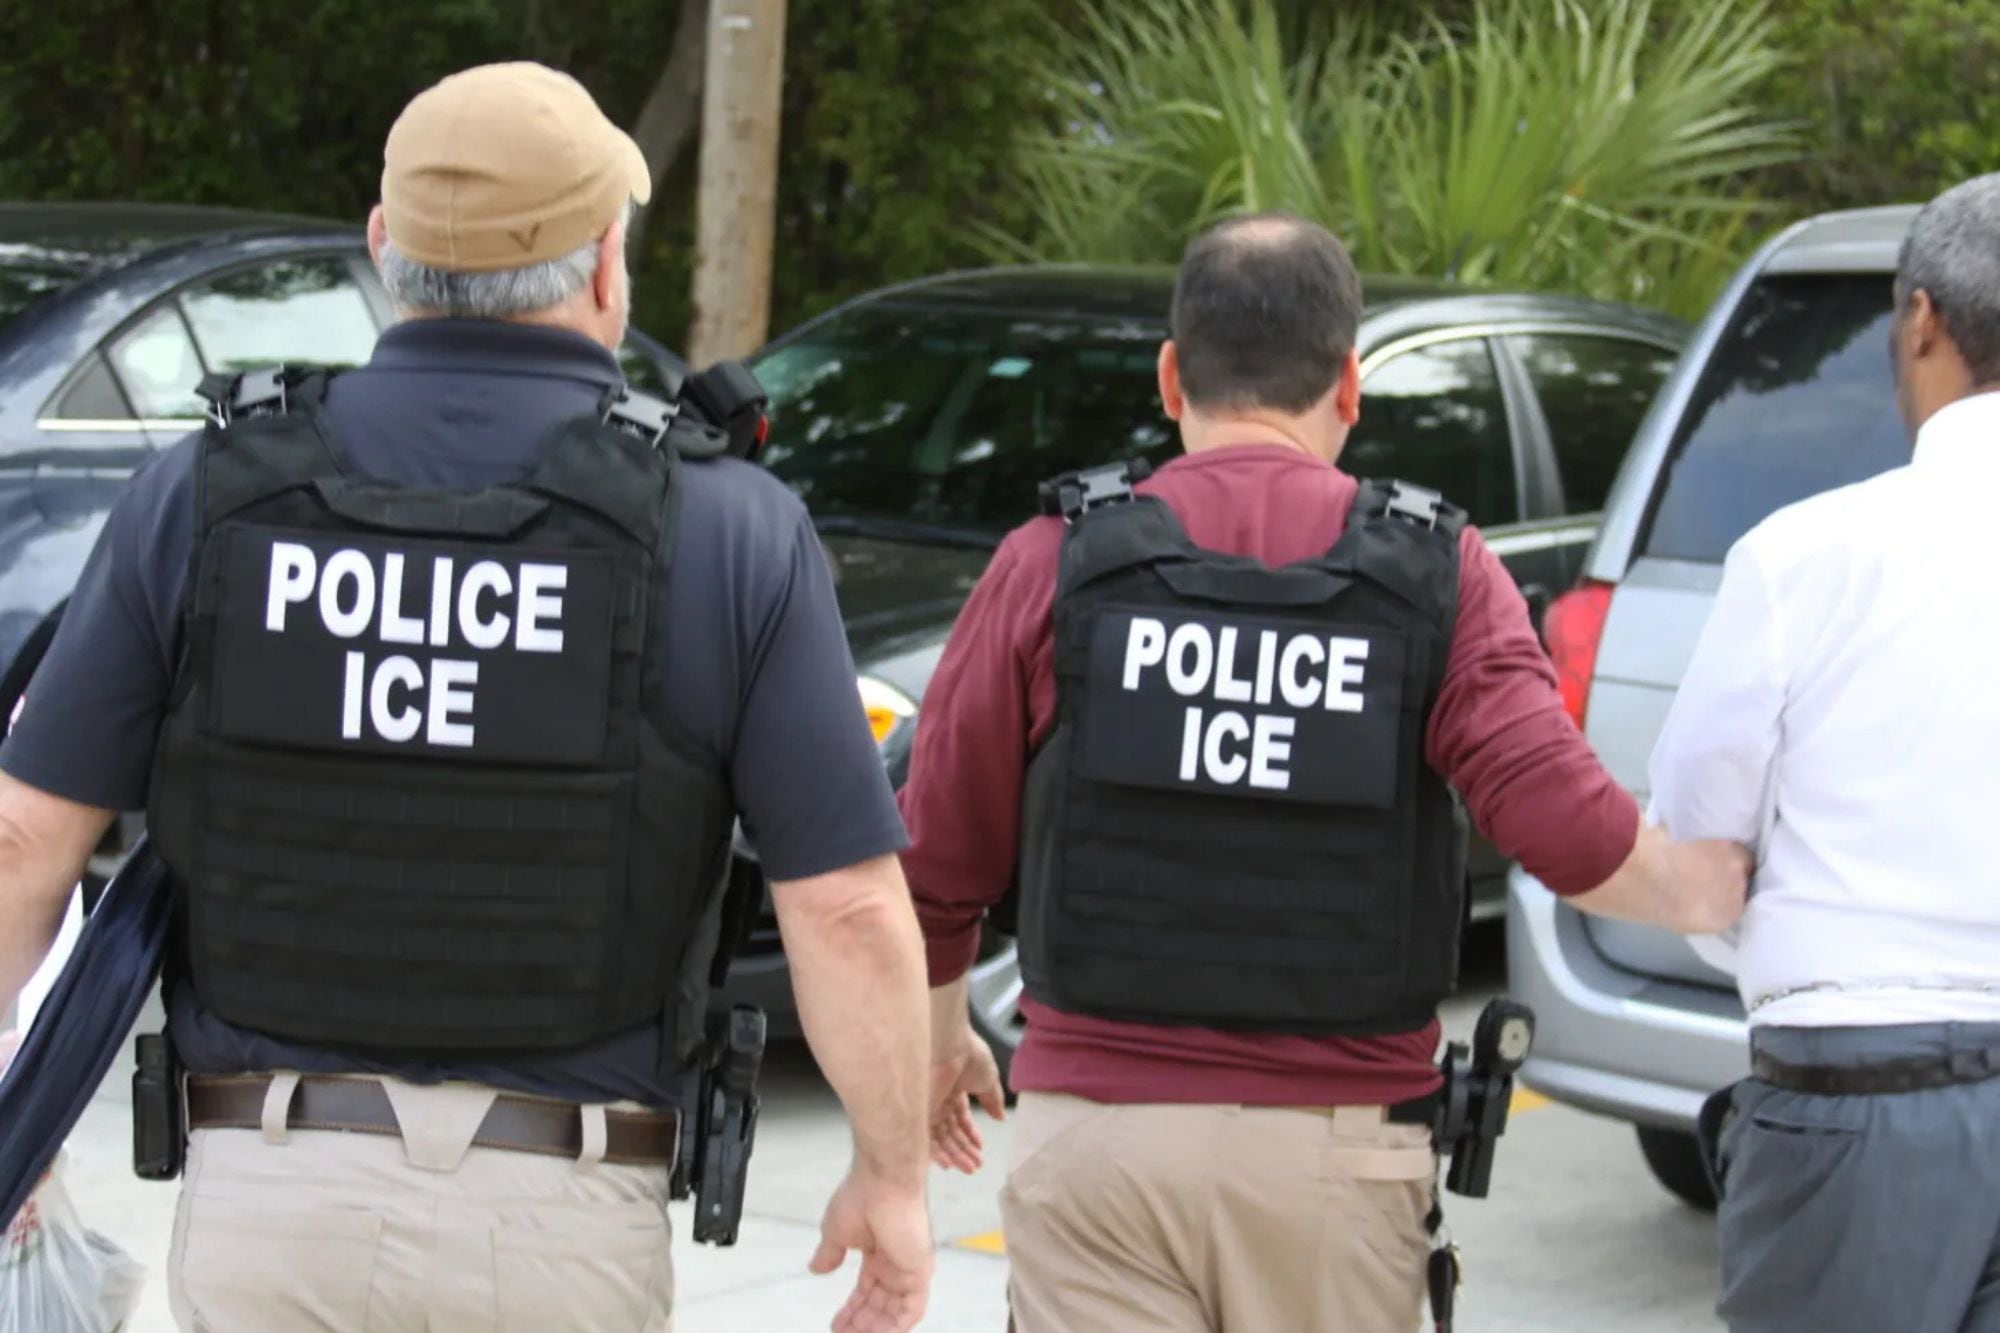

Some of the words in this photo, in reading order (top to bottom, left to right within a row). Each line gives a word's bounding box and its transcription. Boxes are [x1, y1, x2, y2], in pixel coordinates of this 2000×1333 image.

[265, 541, 568, 653] POLICE
[342, 650, 479, 747] ICE
[1122, 616, 1370, 713] POLICE
[1178, 706, 1296, 790] ICE
